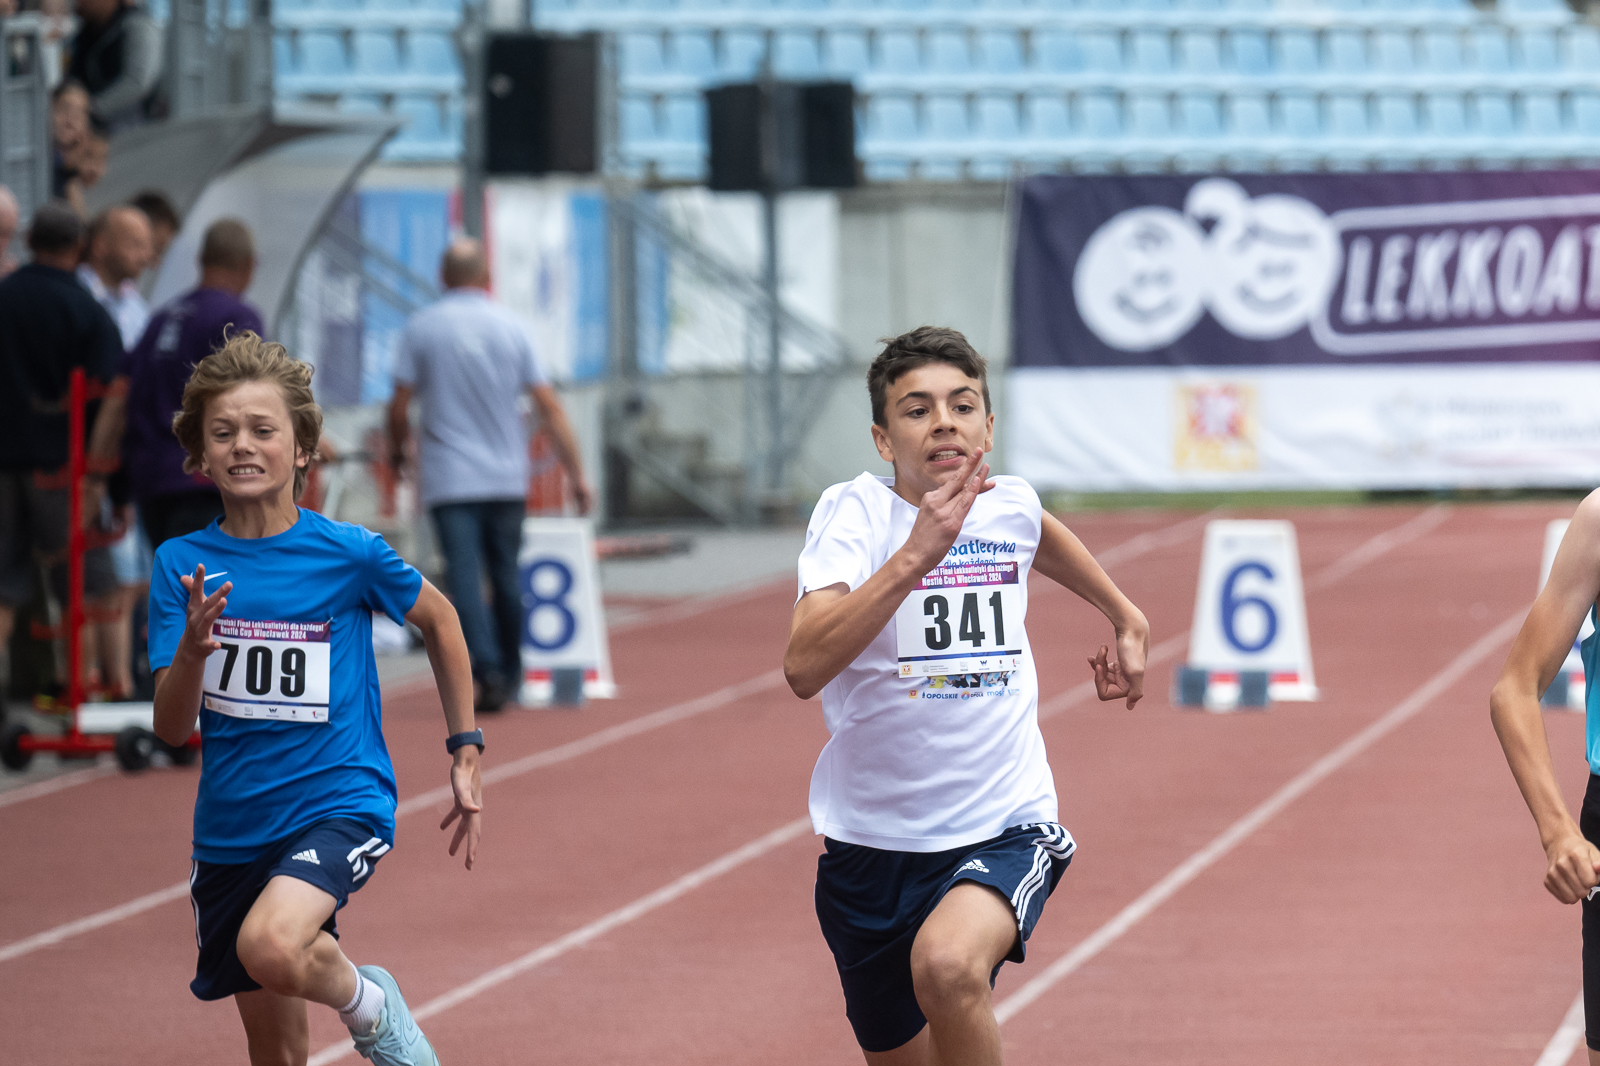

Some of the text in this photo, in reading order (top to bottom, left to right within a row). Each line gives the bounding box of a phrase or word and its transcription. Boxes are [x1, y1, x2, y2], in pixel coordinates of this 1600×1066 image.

[947, 540, 1016, 556] oatletyka
[520, 560, 575, 650] 8
[943, 576, 956, 585] Cup
[988, 573, 1002, 582] 2024
[1220, 560, 1278, 653] 6
[240, 628, 252, 638] Cup
[290, 630, 306, 639] 2024
[923, 591, 1005, 650] 341
[216, 642, 306, 697] 709
